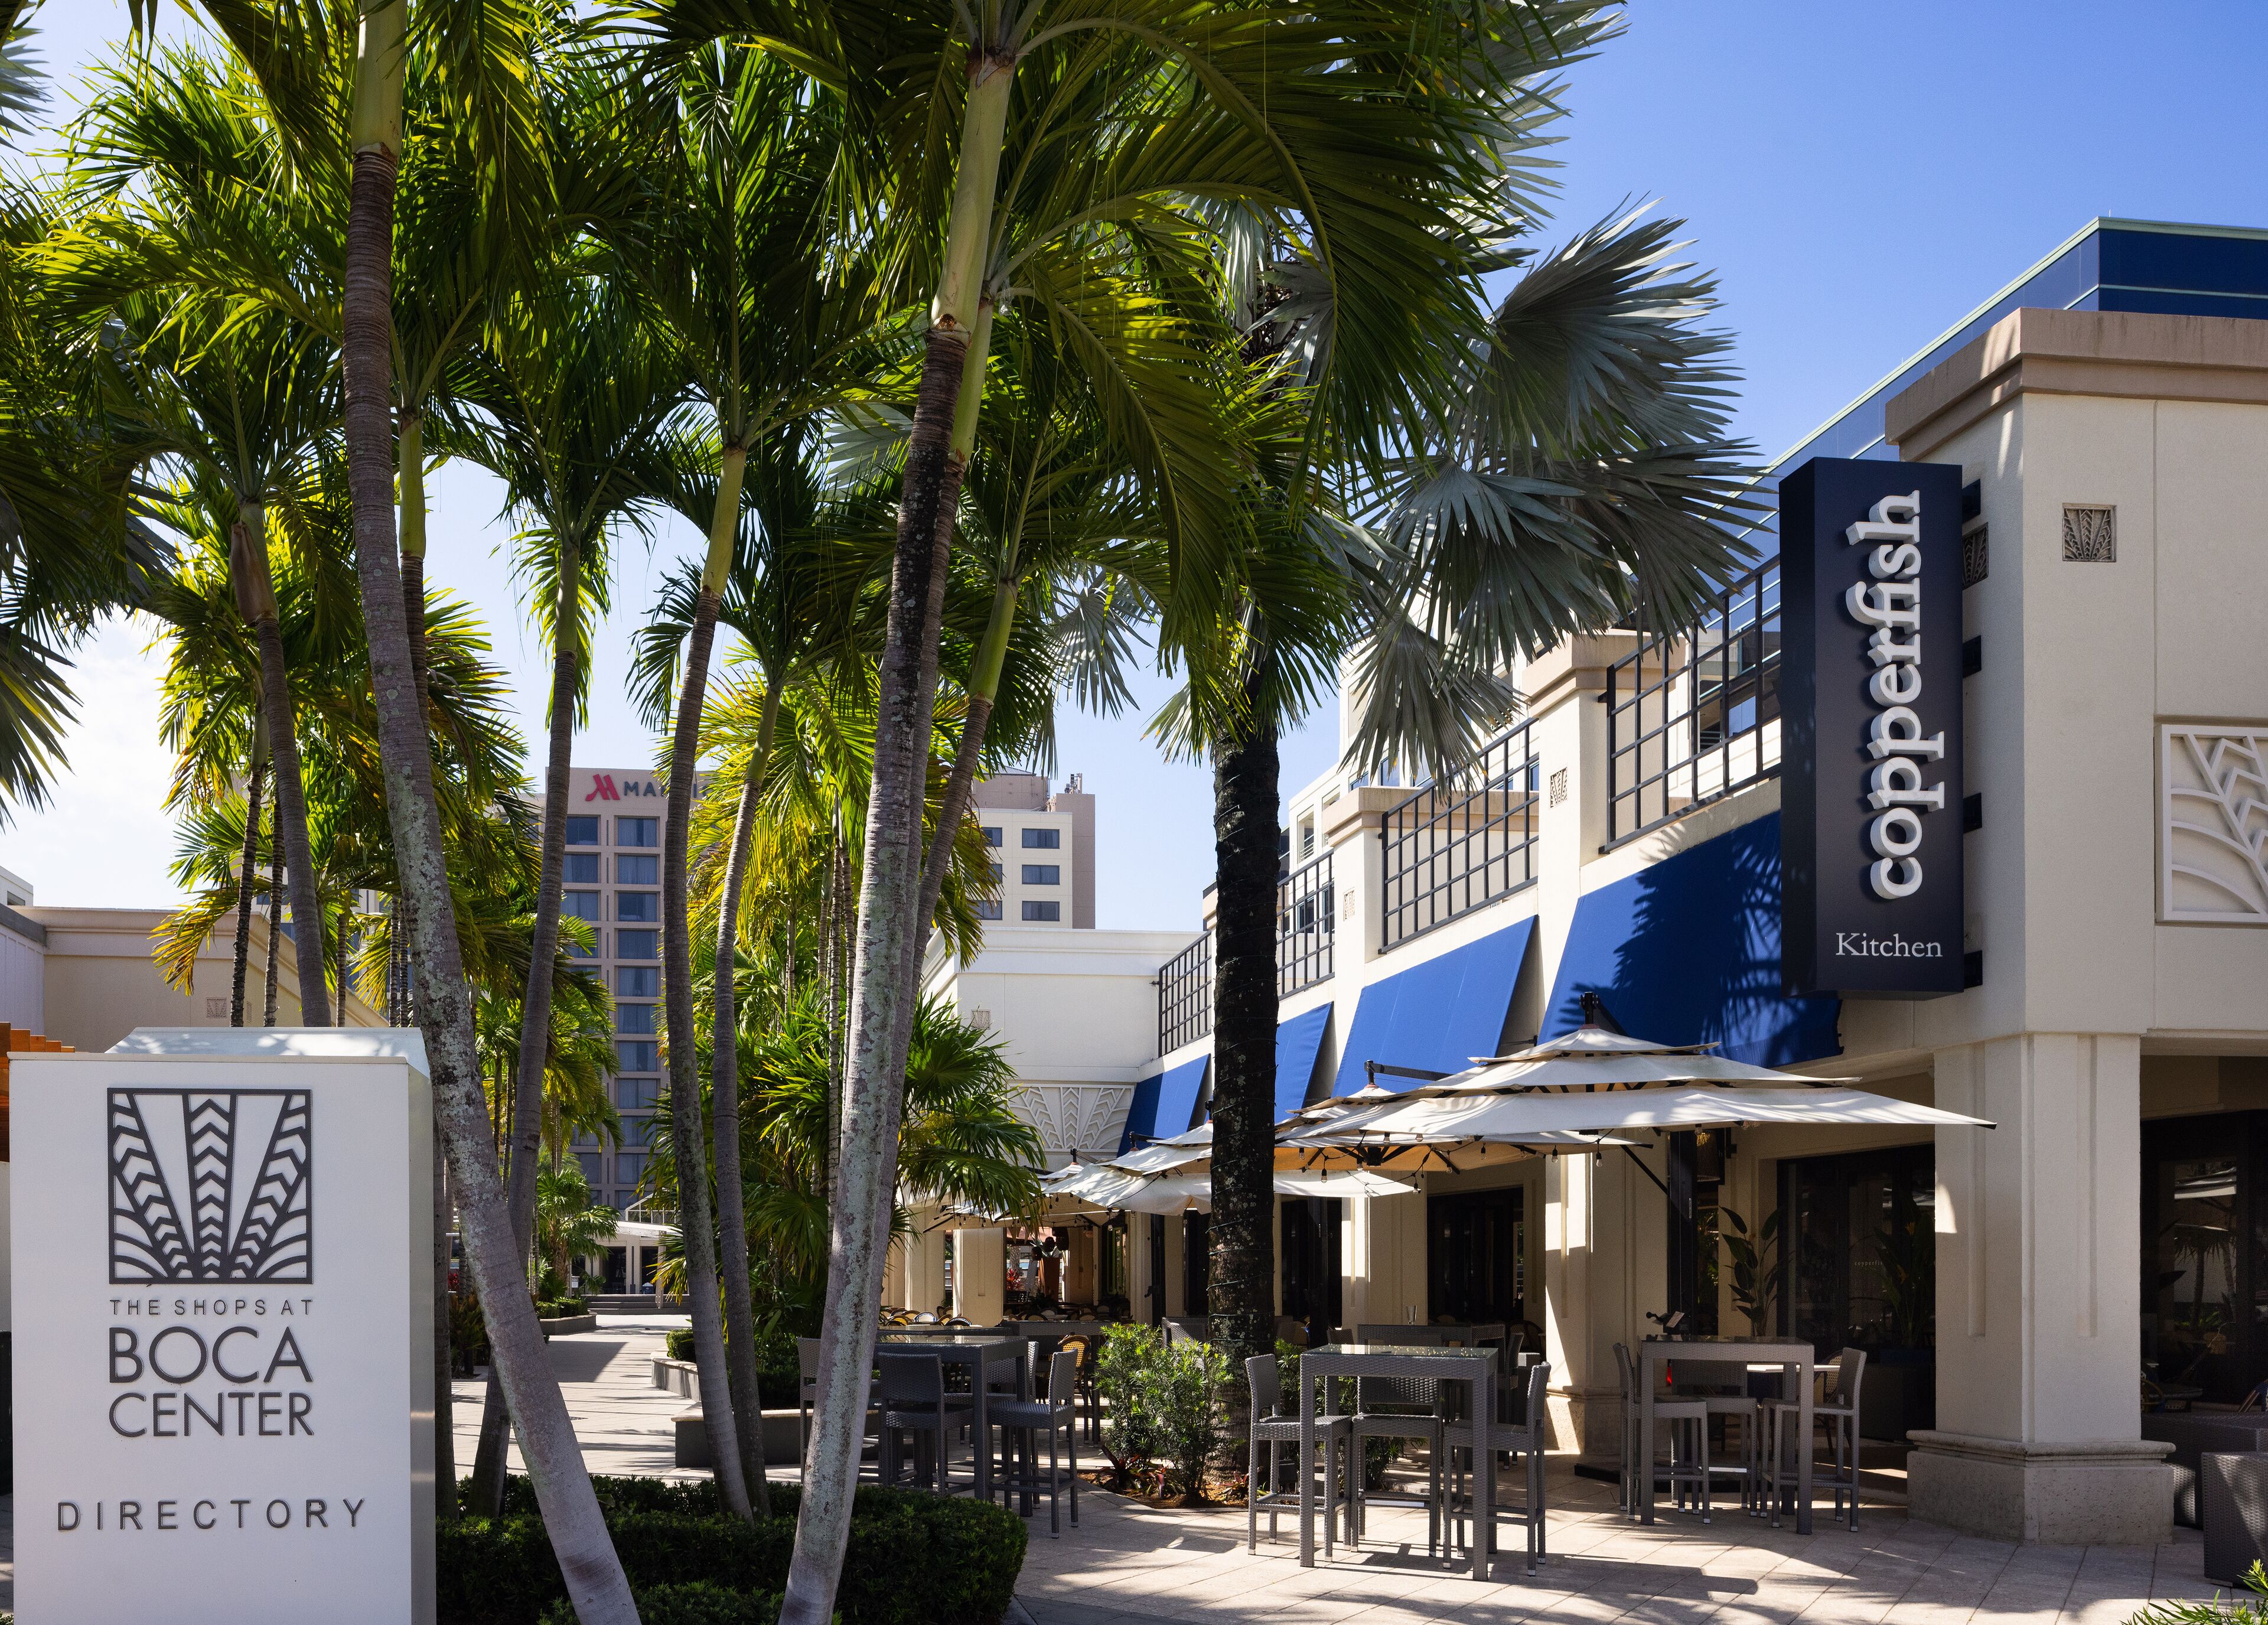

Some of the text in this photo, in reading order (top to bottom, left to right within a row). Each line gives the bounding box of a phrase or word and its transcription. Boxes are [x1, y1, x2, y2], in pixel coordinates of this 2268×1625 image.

[1845, 489, 1945, 900] copperfish
[1835, 932, 1943, 958] Kitchen
[1854, 1259, 1884, 1268] copperfis
[109, 1299, 313, 1315] THE SHOPS AT
[109, 1326, 314, 1384] BOCA
[108, 1392, 315, 1438] CENTER
[57, 1498, 365, 1531] DIRECTORY
